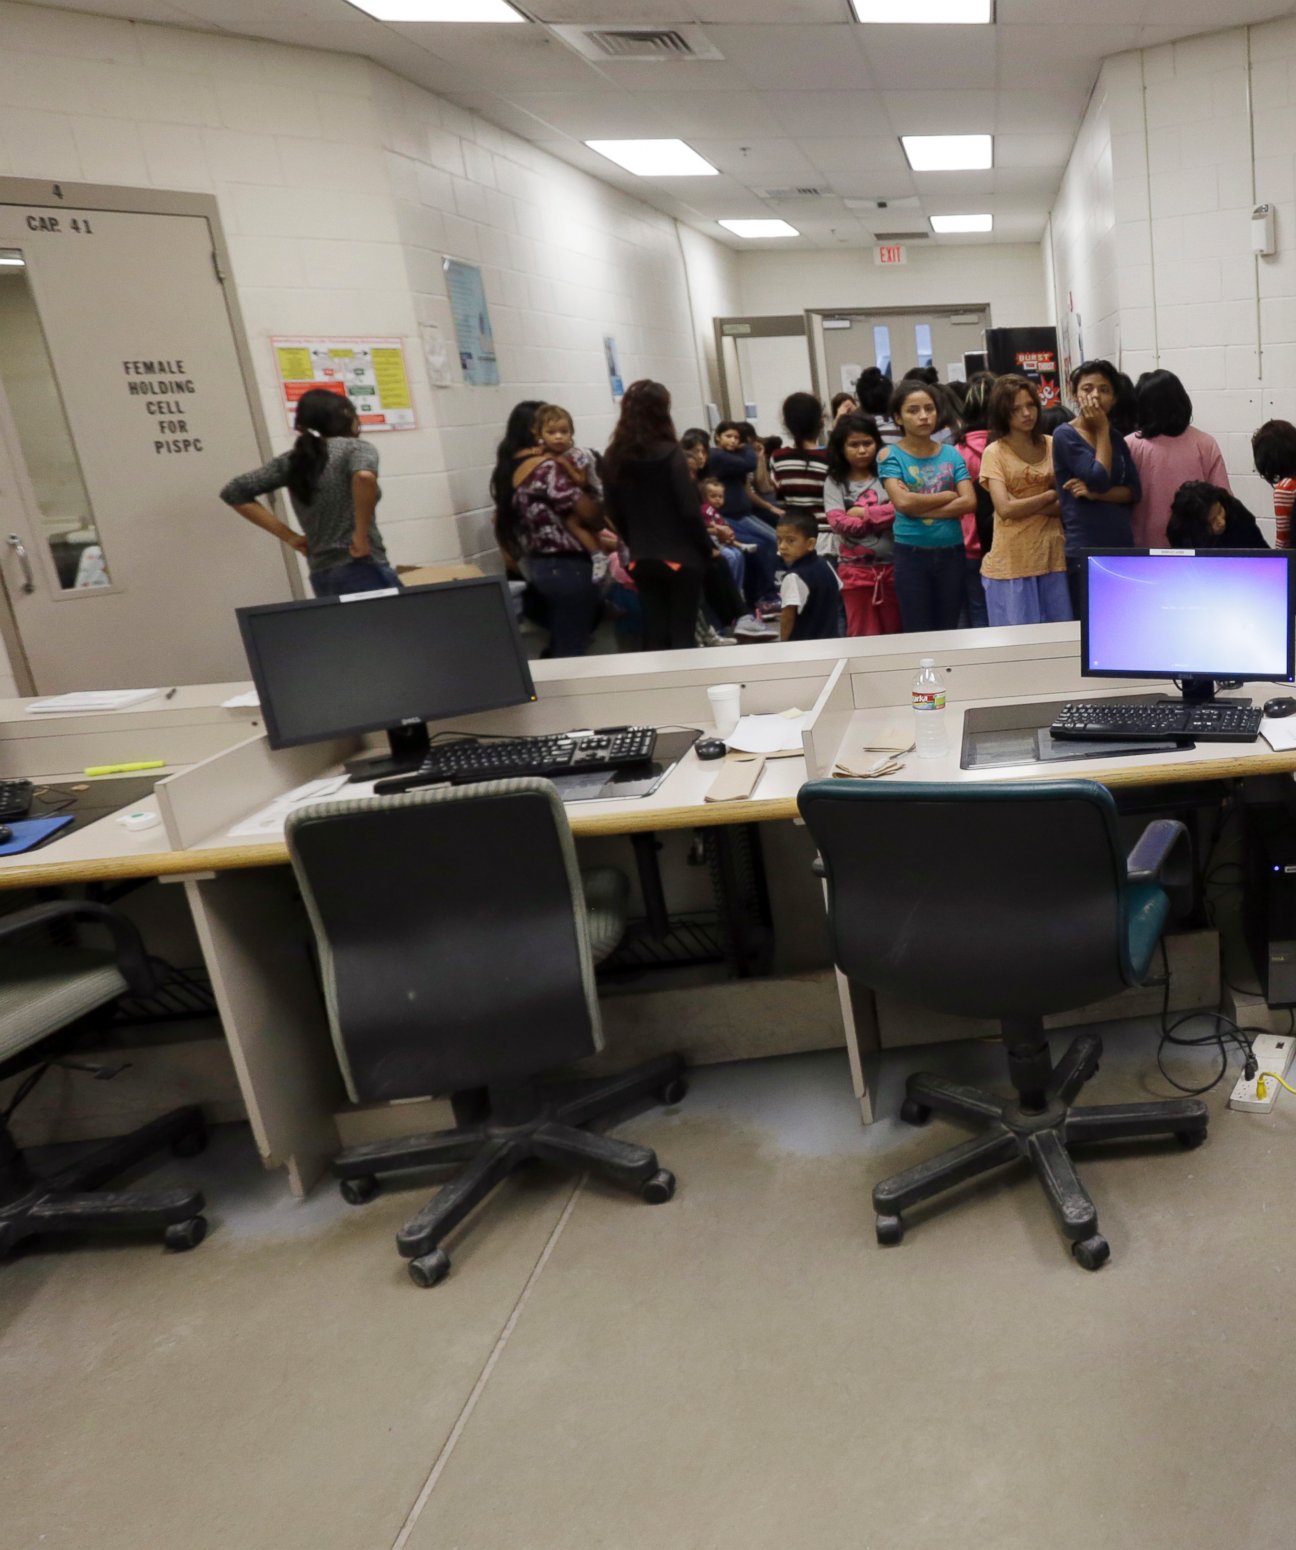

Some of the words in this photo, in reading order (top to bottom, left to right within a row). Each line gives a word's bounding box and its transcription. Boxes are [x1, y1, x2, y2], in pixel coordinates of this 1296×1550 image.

[52, 184, 64, 200] 4
[70, 218, 94, 235] 41
[880, 245, 901, 263] EXIT
[122, 360, 187, 376] FEMALE
[127, 379, 196, 396] HOLDING
[146, 401, 186, 416] CELL
[158, 420, 189, 435] FOR
[153, 438, 204, 455] PISPC
